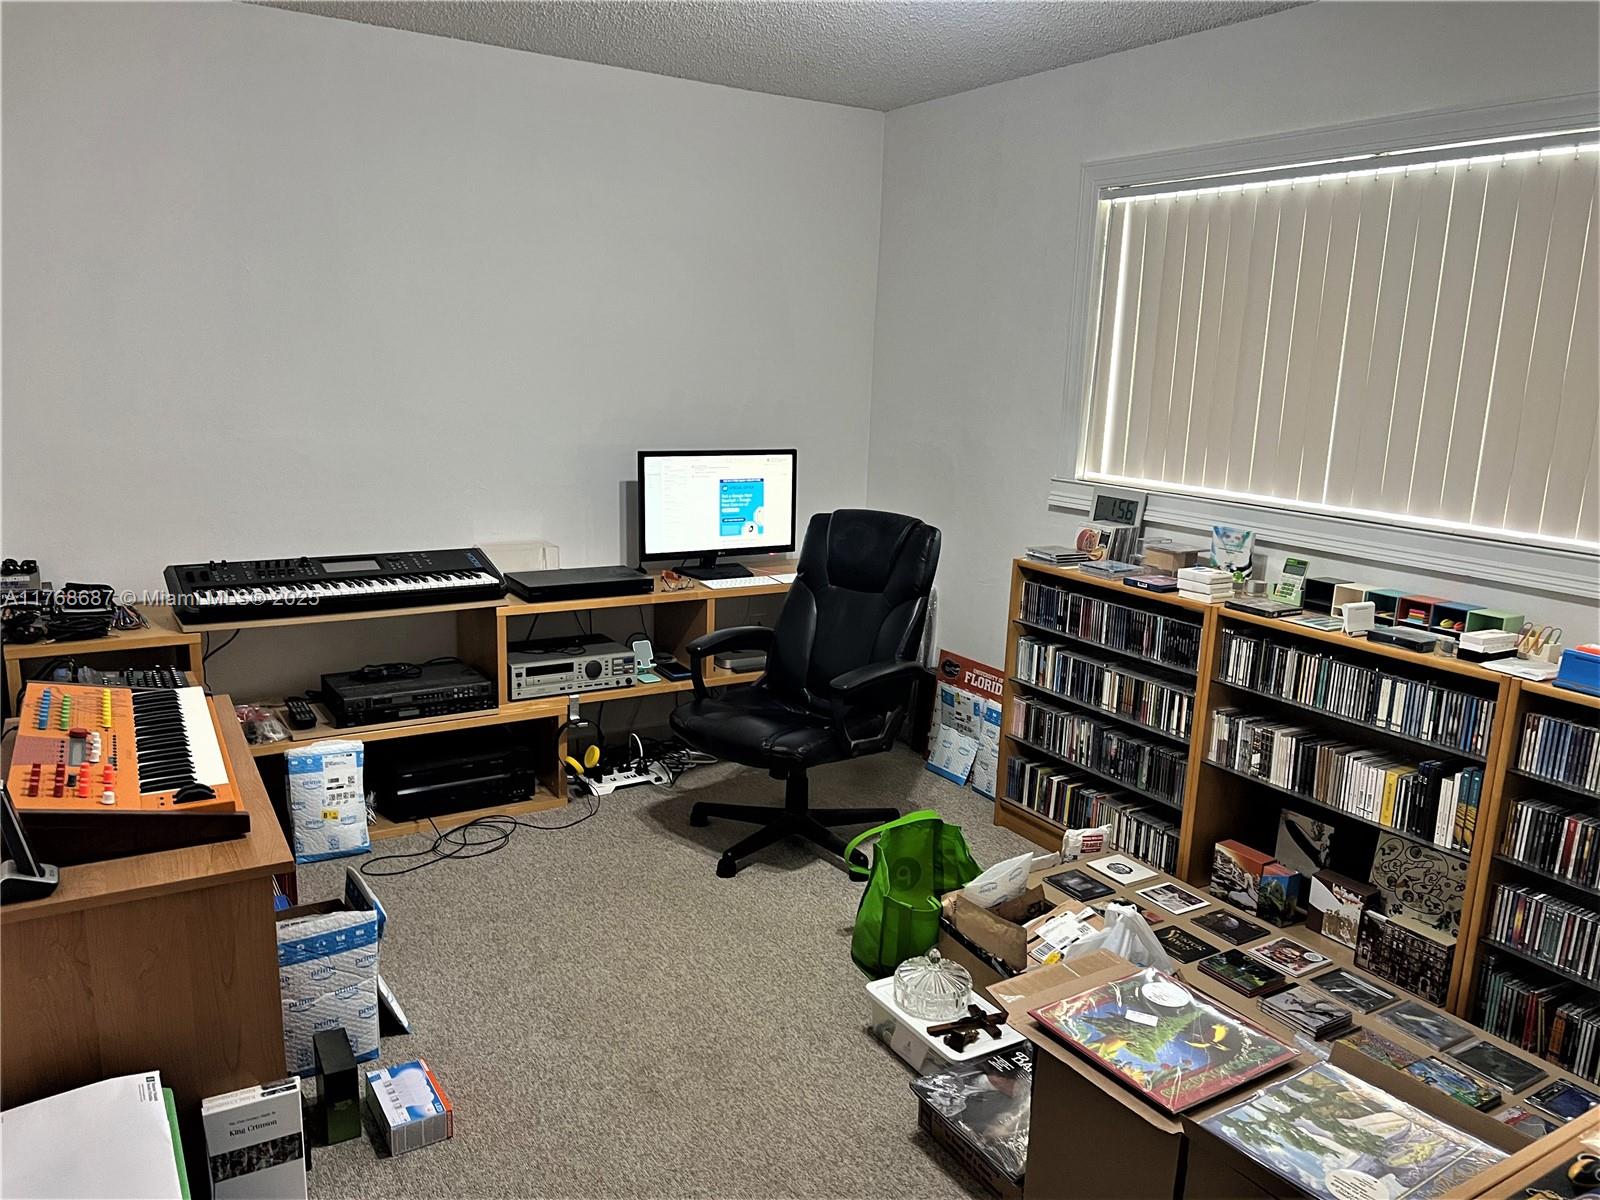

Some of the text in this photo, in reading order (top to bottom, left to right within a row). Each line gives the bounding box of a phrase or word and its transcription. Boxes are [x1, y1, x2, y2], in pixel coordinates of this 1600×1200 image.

[964, 671, 1004, 696] FLORID
[311, 966, 336, 977] prime
[288, 997, 315, 1008] prime
[314, 1017, 340, 1028] prime
[230, 1119, 278, 1137] King Crimson
